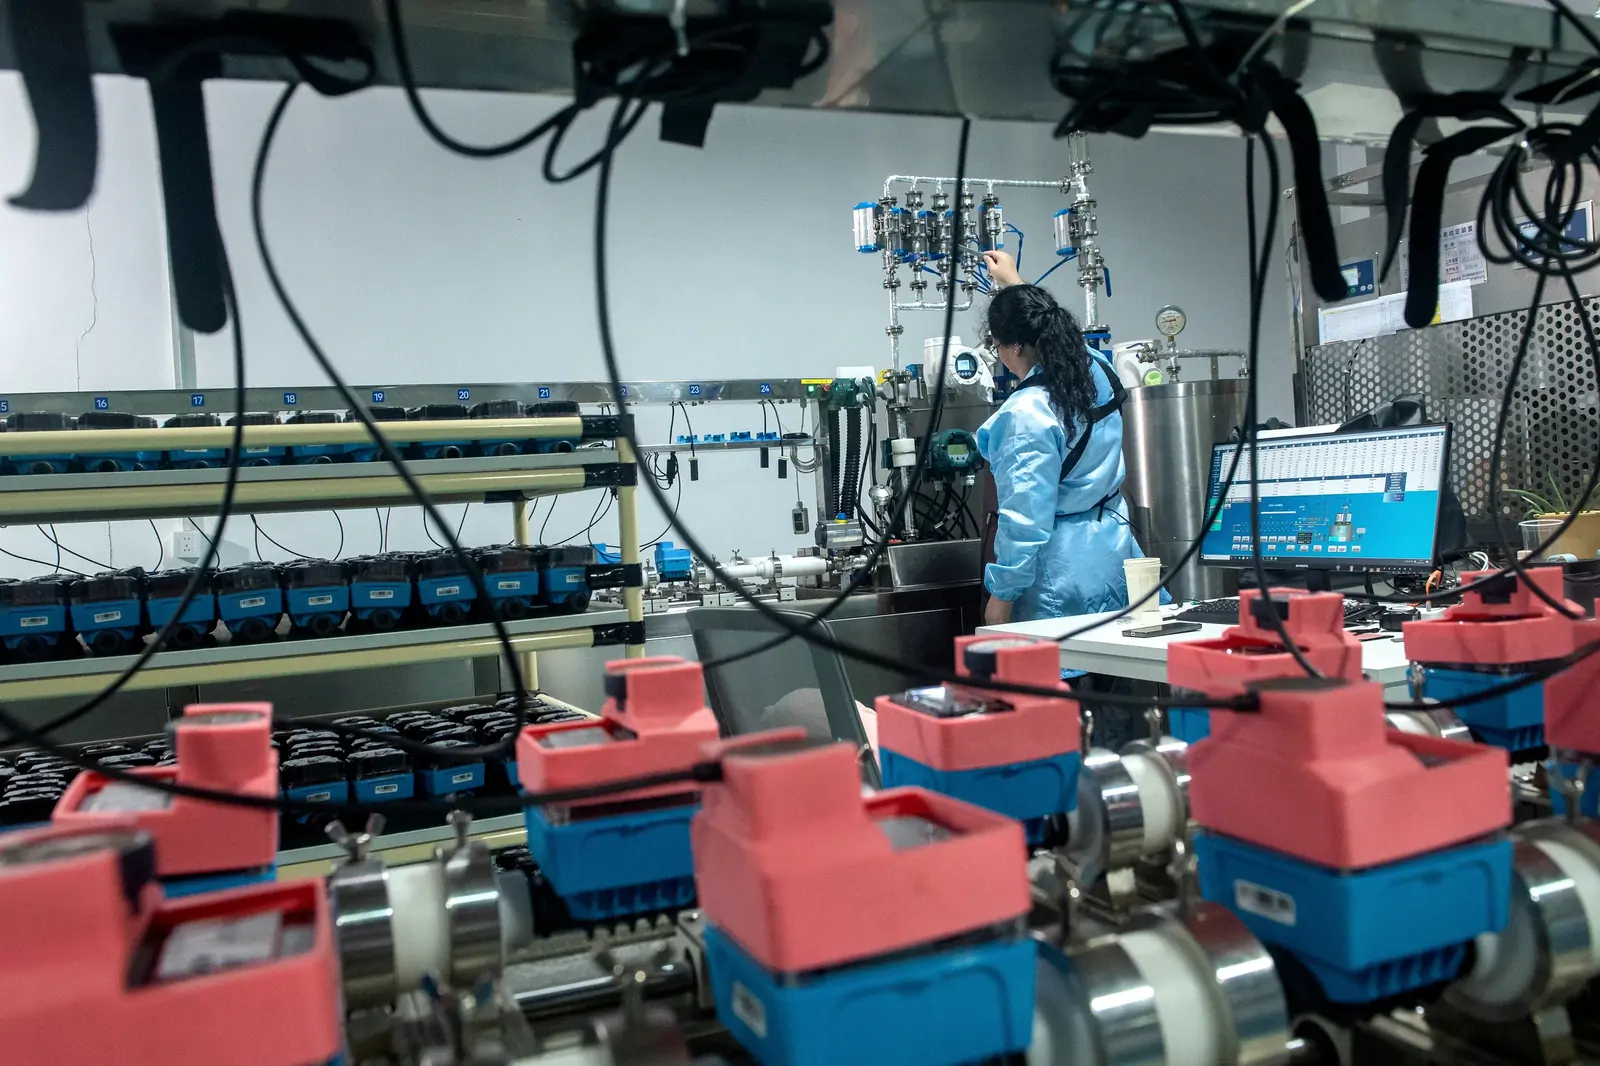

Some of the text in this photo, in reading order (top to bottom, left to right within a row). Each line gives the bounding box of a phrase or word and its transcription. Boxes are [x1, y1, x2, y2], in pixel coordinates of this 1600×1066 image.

[540, 389, 549, 397] 21
[690, 386, 700, 394] 23
[761, 385, 770, 393] 24
[285, 394, 295, 403] 18
[373, 392, 383, 401] 19
[459, 390, 469, 399] 20
[96, 399, 107, 408] 16
[193, 396, 203, 405] 17
[0, 402, 7, 411] 5
